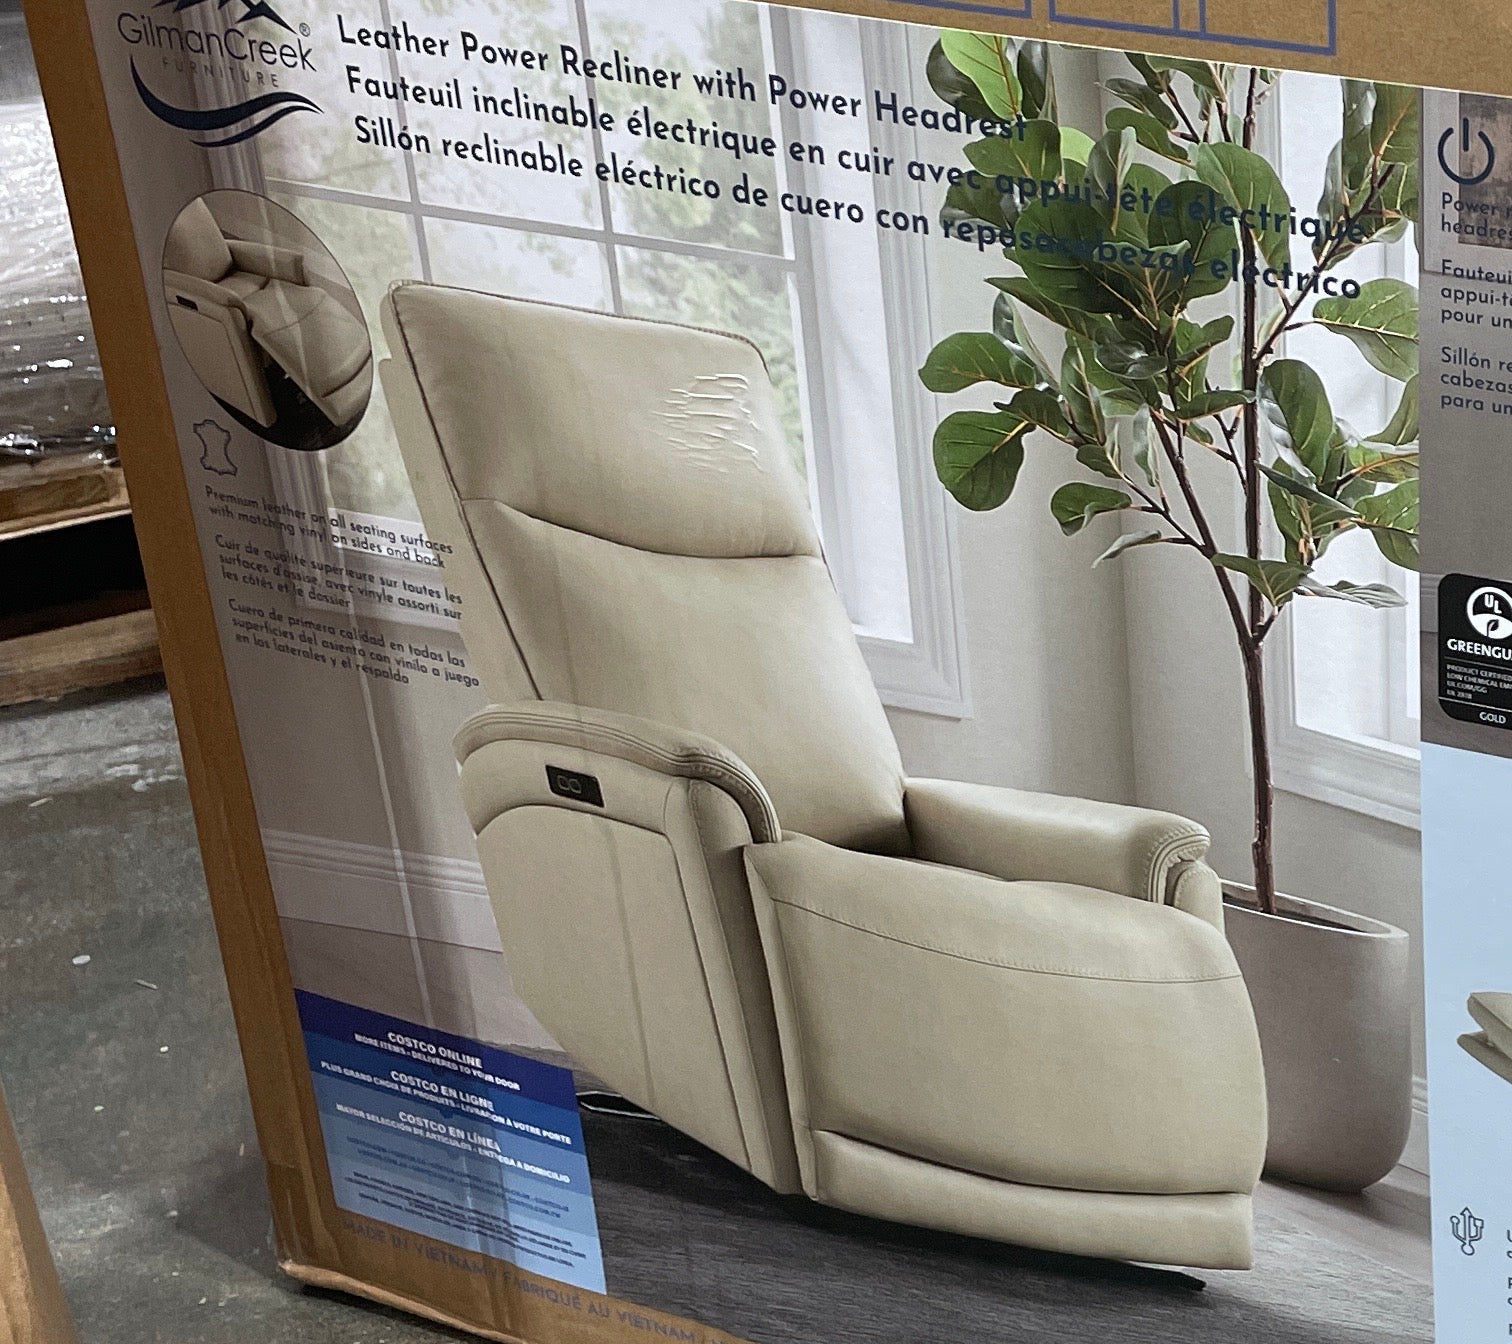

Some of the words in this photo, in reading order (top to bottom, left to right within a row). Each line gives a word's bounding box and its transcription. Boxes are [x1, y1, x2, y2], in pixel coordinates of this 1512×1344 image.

[162, 59, 279, 88] FURNITURE
[337, 14, 449, 57] Leather
[460, 31, 548, 71] Power
[560, 44, 681, 90] Recliner
[693, 67, 756, 102] with
[768, 74, 861, 117] Power
[875, 89, 1027, 142] Headrest
[345, 64, 462, 109] Fauteuil
[472, 86, 615, 132] inclinable
[627, 106, 776, 160] électrique
[789, 142, 825, 165] en
[838, 147, 892, 178] cuir
[908, 162, 981, 190] avec
[995, 173, 1172, 219] appui-tête
[1188, 192, 1366, 246] électrique
[354, 115, 431, 154] Sillón
[441, 132, 583, 177] reclinable
[595, 151, 720, 199] eléctrico
[732, 172, 769, 207] de
[781, 193, 864, 223] cuero
[1442, 192, 1499, 216] Power
[1441, 309, 1484, 325] pour
[1491, 316, 1512, 329] un
[206, 486, 259, 507] Premium
[263, 499, 306, 520] leather
[311, 515, 326, 524] on
[330, 516, 346, 528] all
[350, 522, 396, 544] seating
[400, 533, 452, 554] surfaces
[210, 506, 233, 519] with
[238, 510, 295, 536] matching
[300, 526, 327, 542] vinyl
[332, 534, 347, 546] on
[352, 537, 382, 554] sides
[387, 546, 410, 560] and
[416, 552, 445, 568] back
[1479, 711, 1507, 724] GOLD
[387, 1032, 437, 1054] COSTCO
[438, 1046, 483, 1069] ONLINE
[390, 1070, 439, 1093] COSTCO
[440, 1085, 458, 1099] EN
[458, 1091, 495, 1112] LIGNE
[398, 1111, 447, 1134] COSTCO
[447, 1126, 465, 1140] EN
[466, 1132, 502, 1153] LÍNEA
[619, 1311, 695, 1344] VIETNAM
